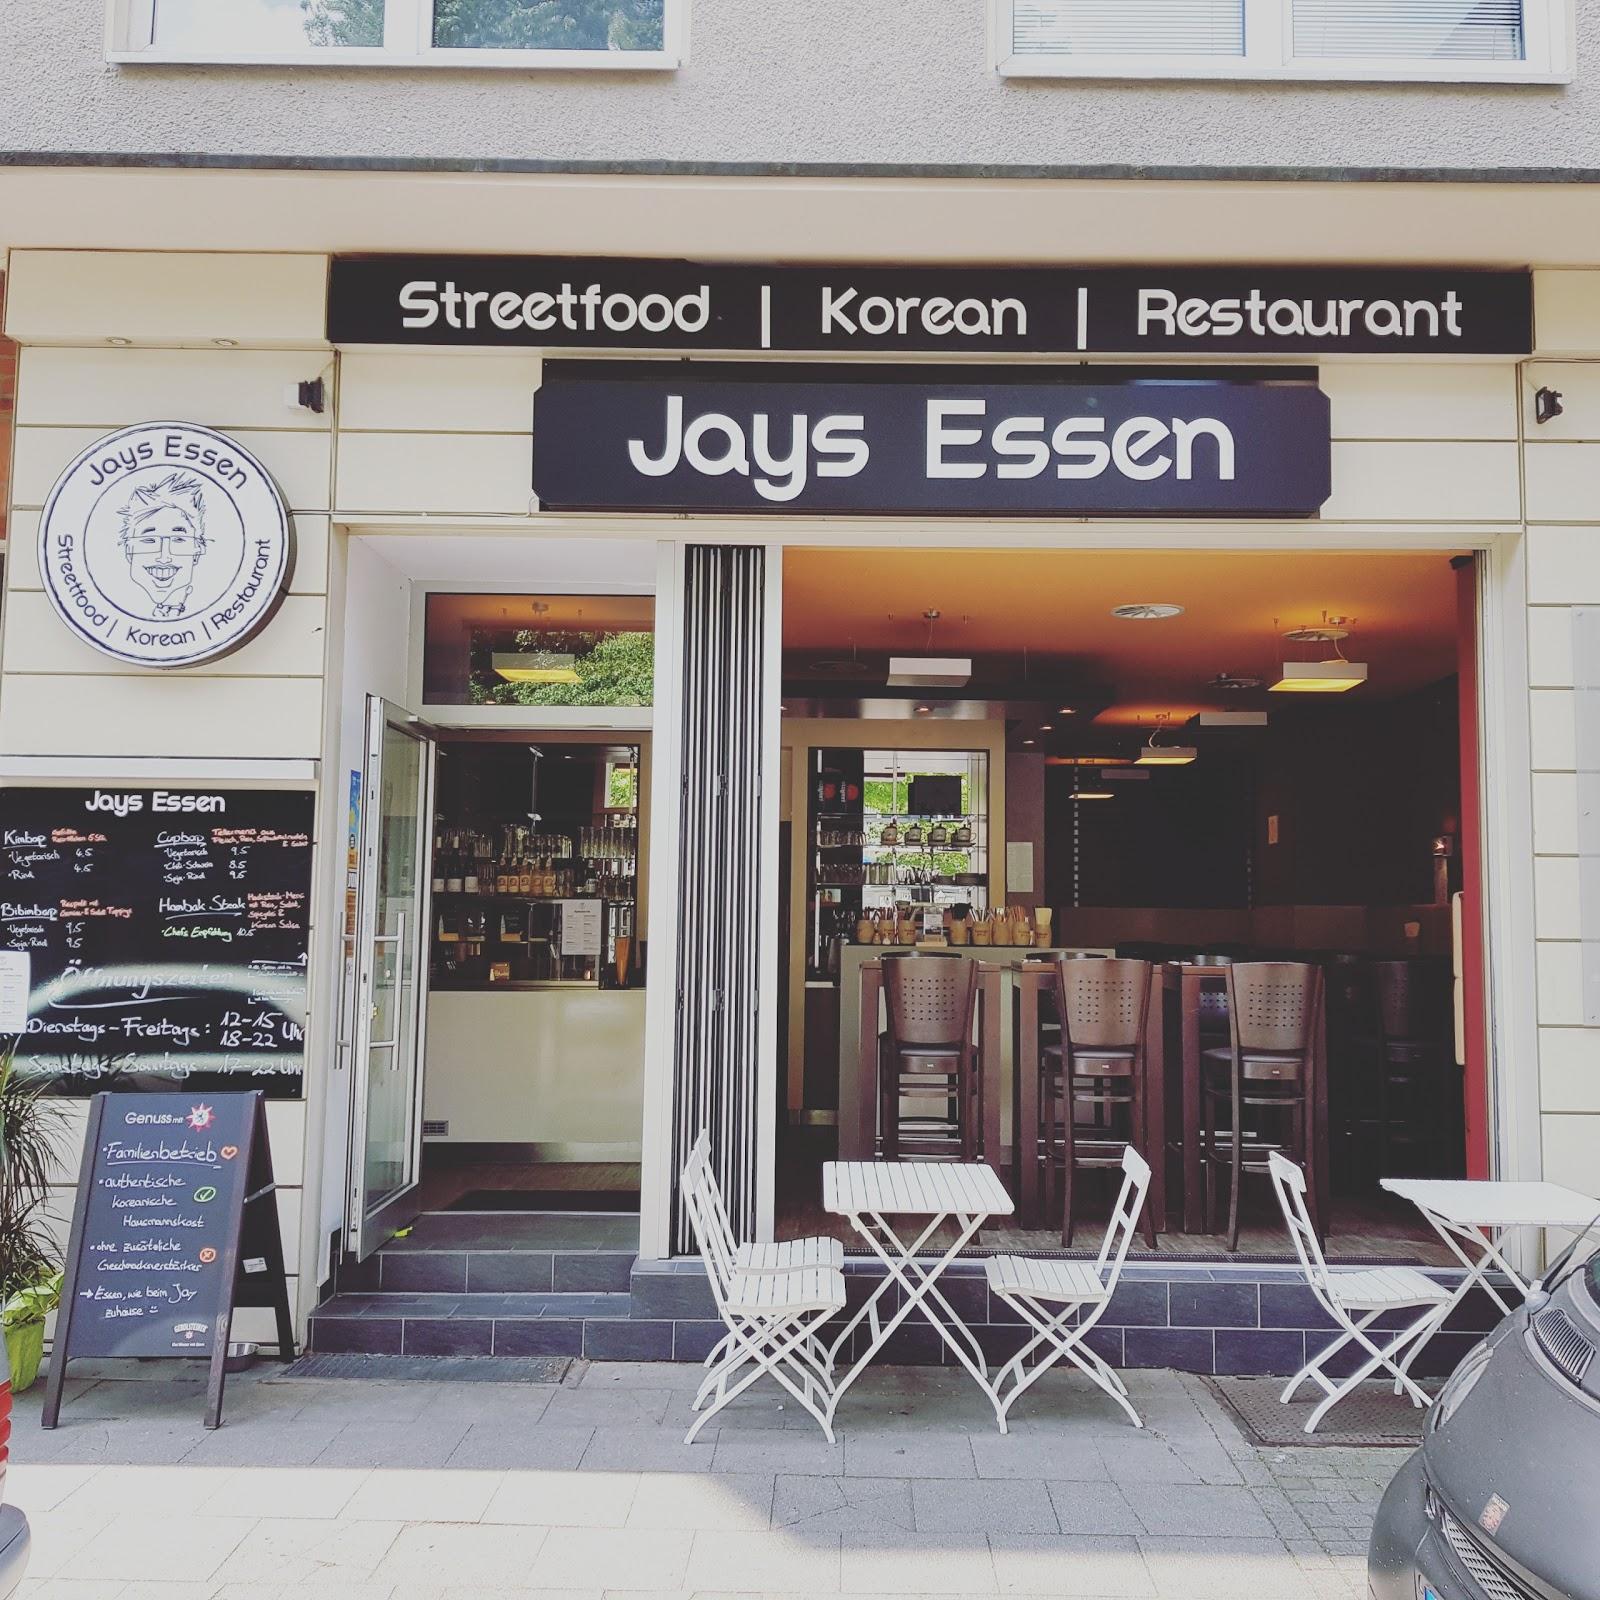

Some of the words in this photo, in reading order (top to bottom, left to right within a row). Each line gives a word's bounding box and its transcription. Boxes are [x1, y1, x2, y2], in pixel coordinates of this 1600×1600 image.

[399, 281, 710, 333] Streetfood
[821, 286, 1028, 335] Korean
[1137, 288, 1463, 337] Restaurant
[628, 395, 869, 502] Jays
[926, 399, 1236, 481] Essen
[89, 440, 154, 486] Jays
[164, 434, 248, 490] Essen
[57, 534, 109, 627] Streetfood
[126, 625, 196, 647] Korean
[209, 538, 271, 630] Restaurant
[85, 790, 144, 817] Jays
[151, 791, 226, 812] Essen
[125, 1112, 172, 1125] Genuss
[106, 1140, 217, 1163] Familienbetrieb
[104, 1173, 186, 1189] authentische
[96, 1241, 118, 1253] ohne
[127, 1289, 142, 1299] wie
[146, 1286, 168, 1298] beim
